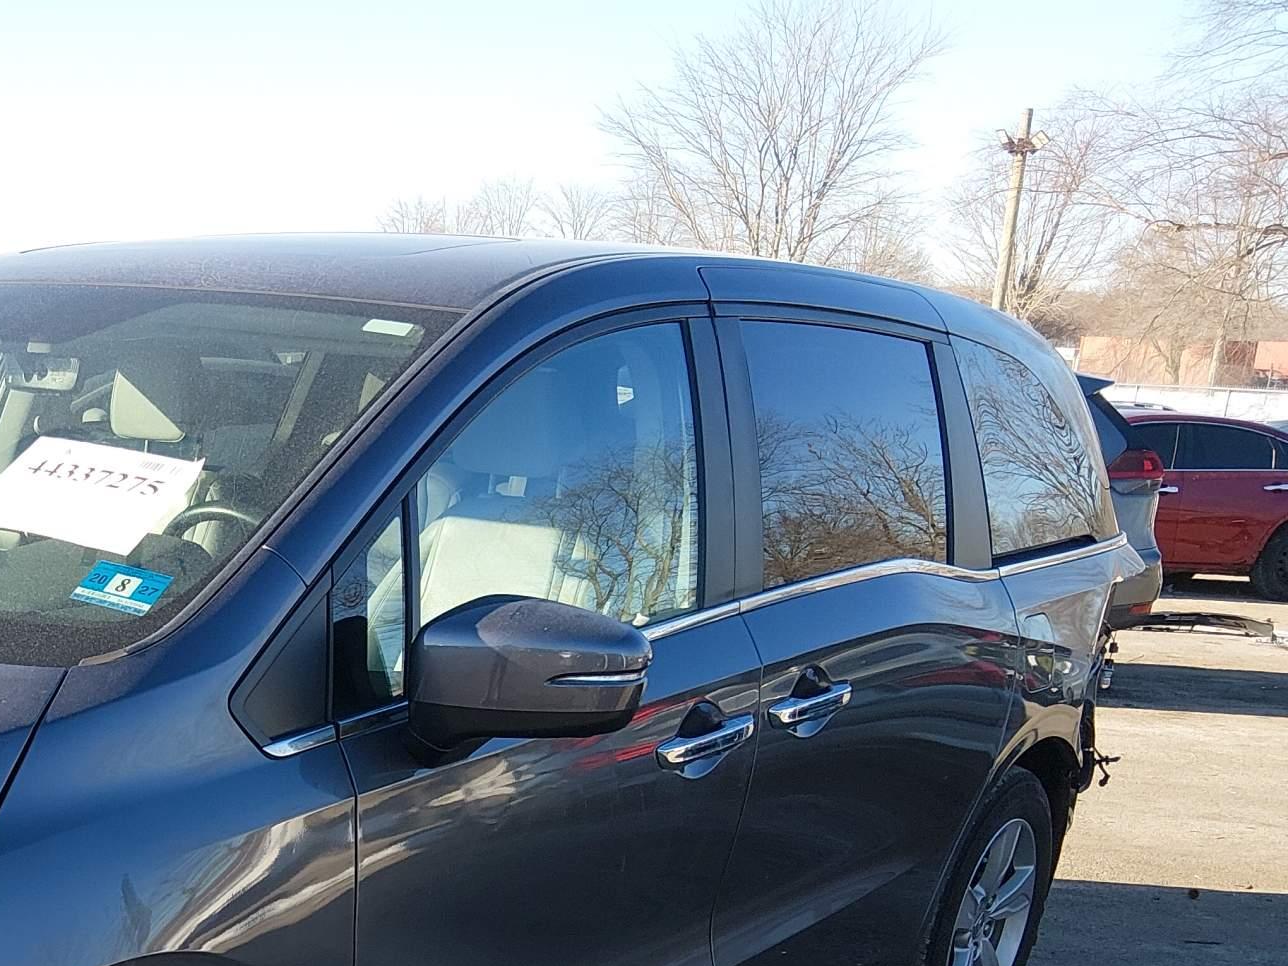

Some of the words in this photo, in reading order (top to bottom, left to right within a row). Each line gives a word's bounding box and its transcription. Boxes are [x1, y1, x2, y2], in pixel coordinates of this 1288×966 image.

[27, 459, 166, 496] 44337275
[88, 572, 109, 585] 20
[114, 578, 131, 593] 8
[138, 585, 159, 597] 27
